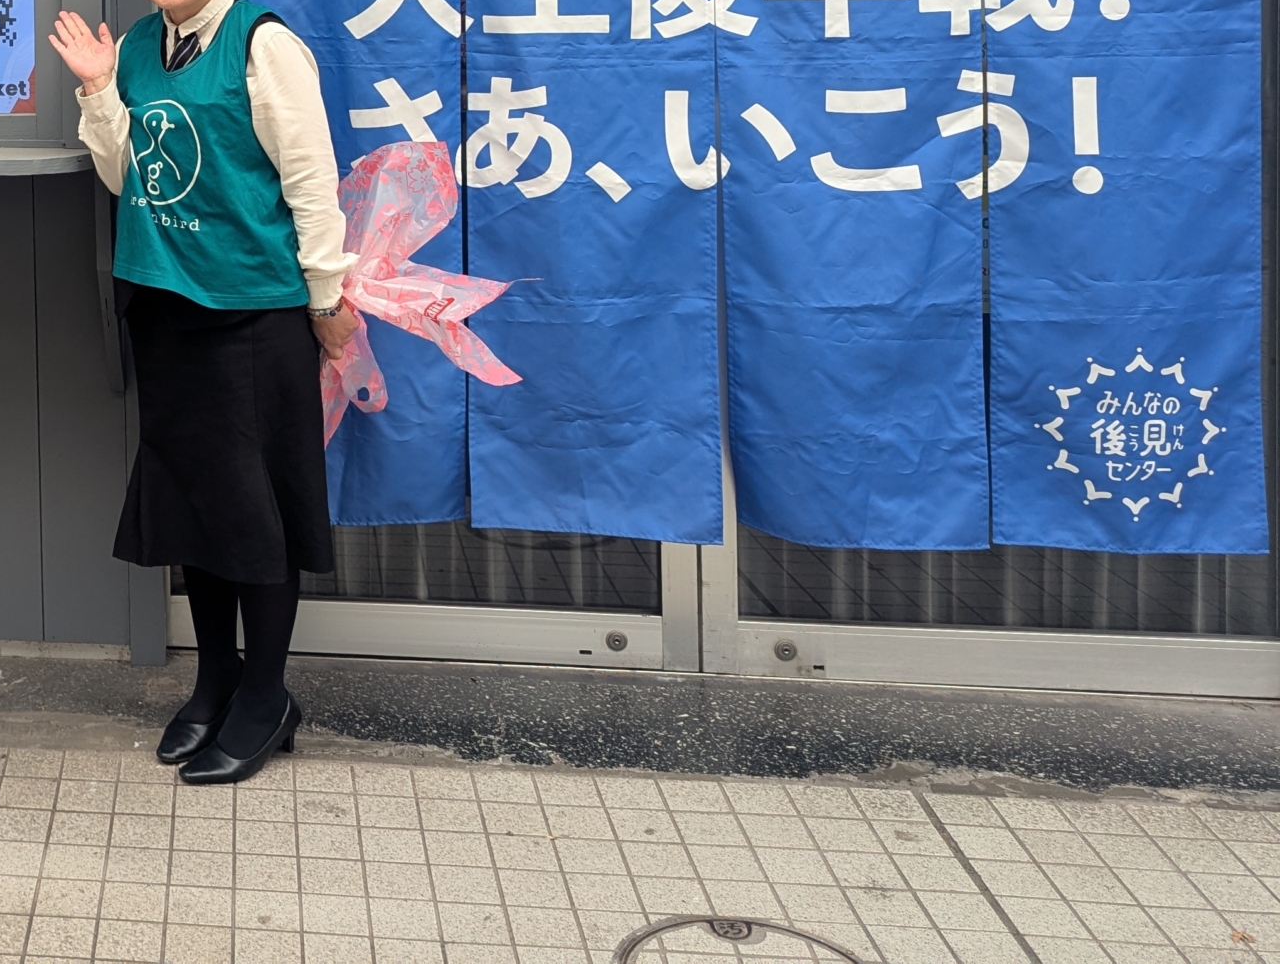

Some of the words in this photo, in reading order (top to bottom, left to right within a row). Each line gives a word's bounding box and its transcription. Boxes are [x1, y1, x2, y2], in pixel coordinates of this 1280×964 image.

[1096, 390, 1181, 416] みんなの
[1089, 418, 1172, 457] 後見
[1105, 460, 1172, 482] センター
